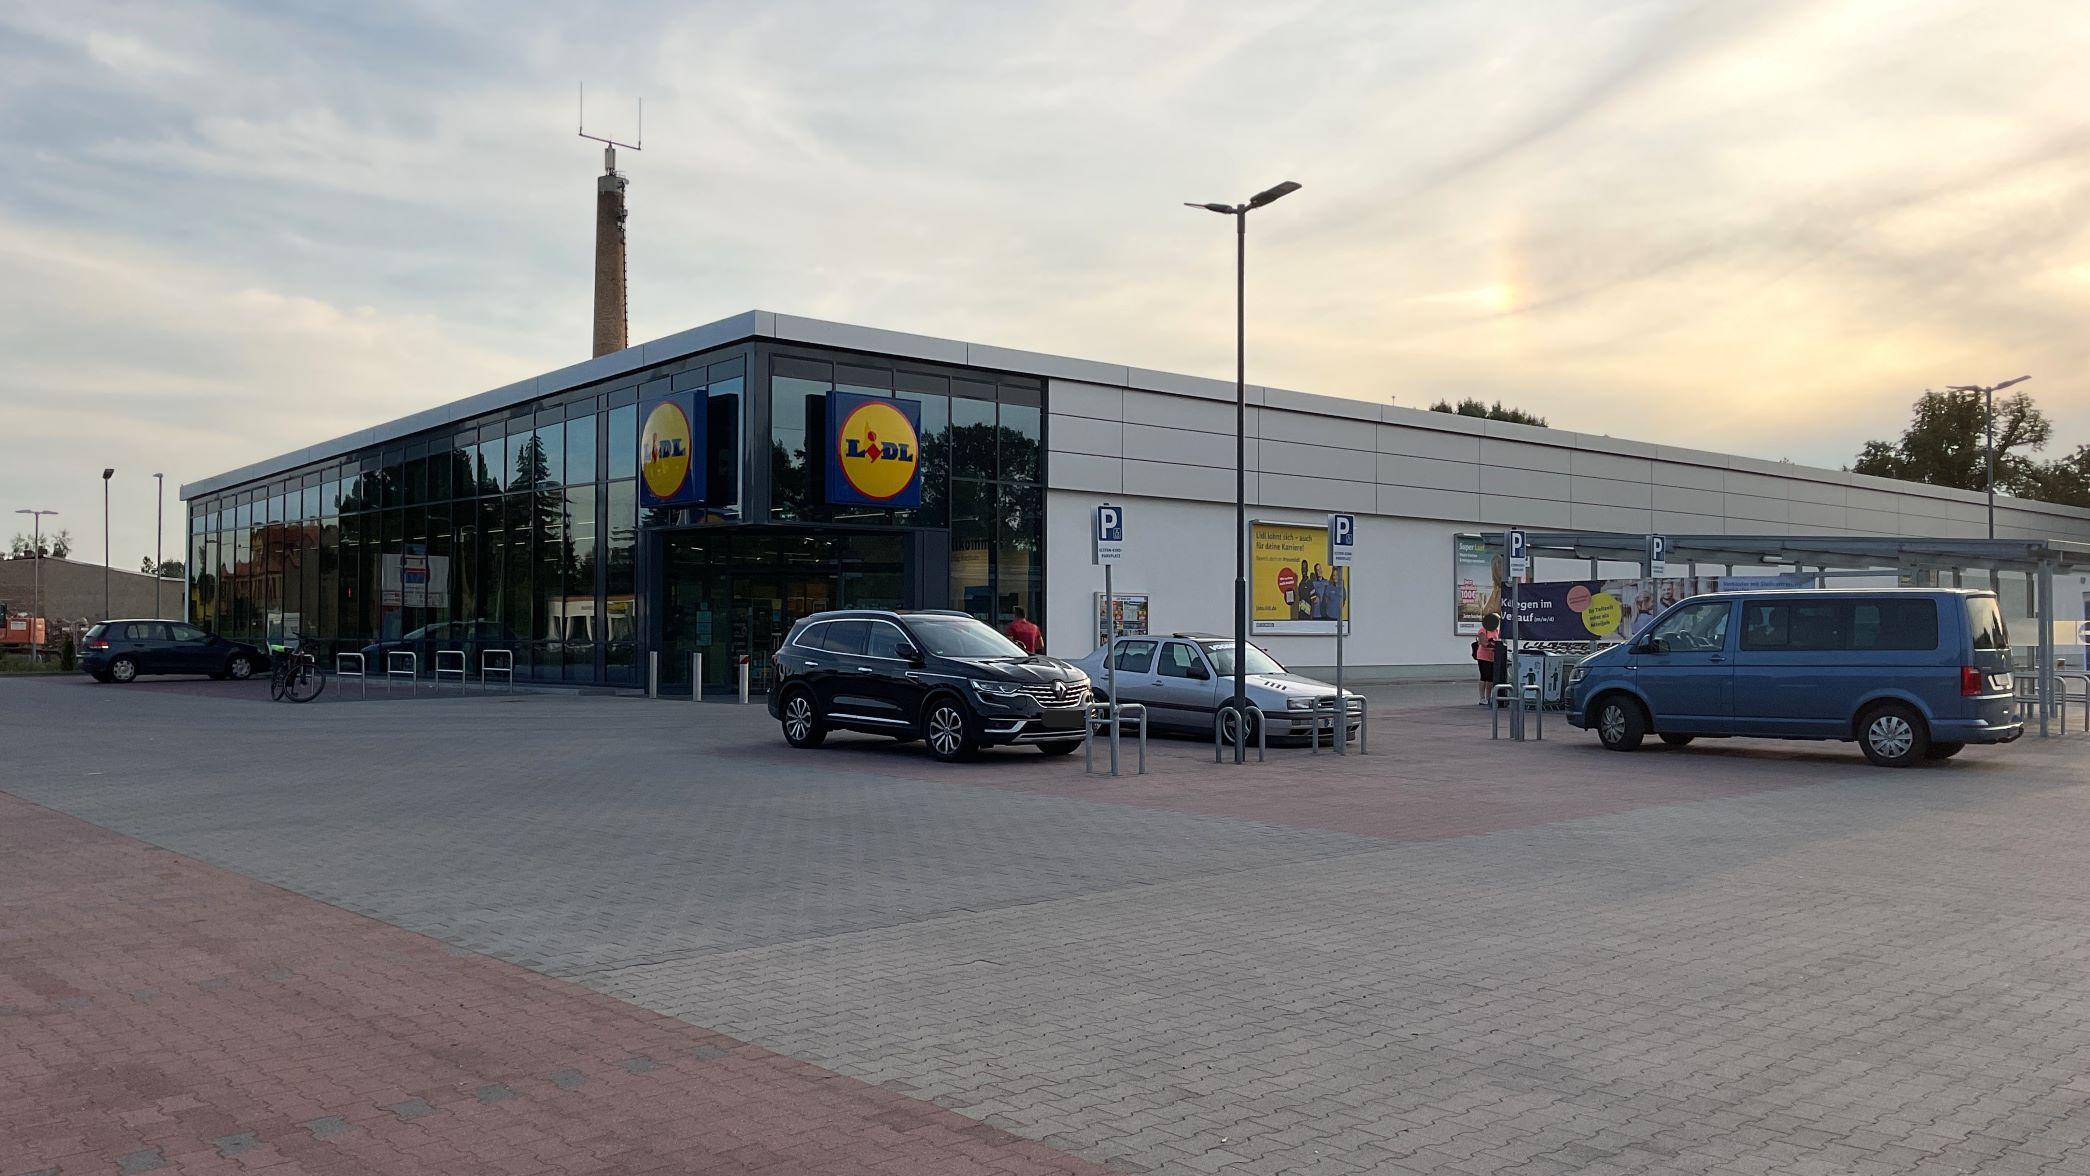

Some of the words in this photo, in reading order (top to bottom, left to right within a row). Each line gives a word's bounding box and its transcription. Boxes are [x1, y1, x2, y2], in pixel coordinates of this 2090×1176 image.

[643, 432, 686, 464] LIDL
[845, 431, 913, 463] LIDL
[1101, 509, 1118, 539] P
[1336, 517, 1350, 544] P
[1255, 531, 1267, 540] Lidl
[1267, 532, 1282, 541] lohnt
[1282, 533, 1294, 542] sich
[1299, 534, 1313, 542] auch
[1255, 541, 1264, 549] für
[1265, 542, 1281, 550] deine
[1281, 543, 1305, 552] Karriere!
[1459, 542, 1474, 551] Super
[1511, 532, 1523, 557] P
[1653, 537, 1663, 560] P
[1461, 590, 1476, 599] 100€
[1540, 599, 1552, 609] im
